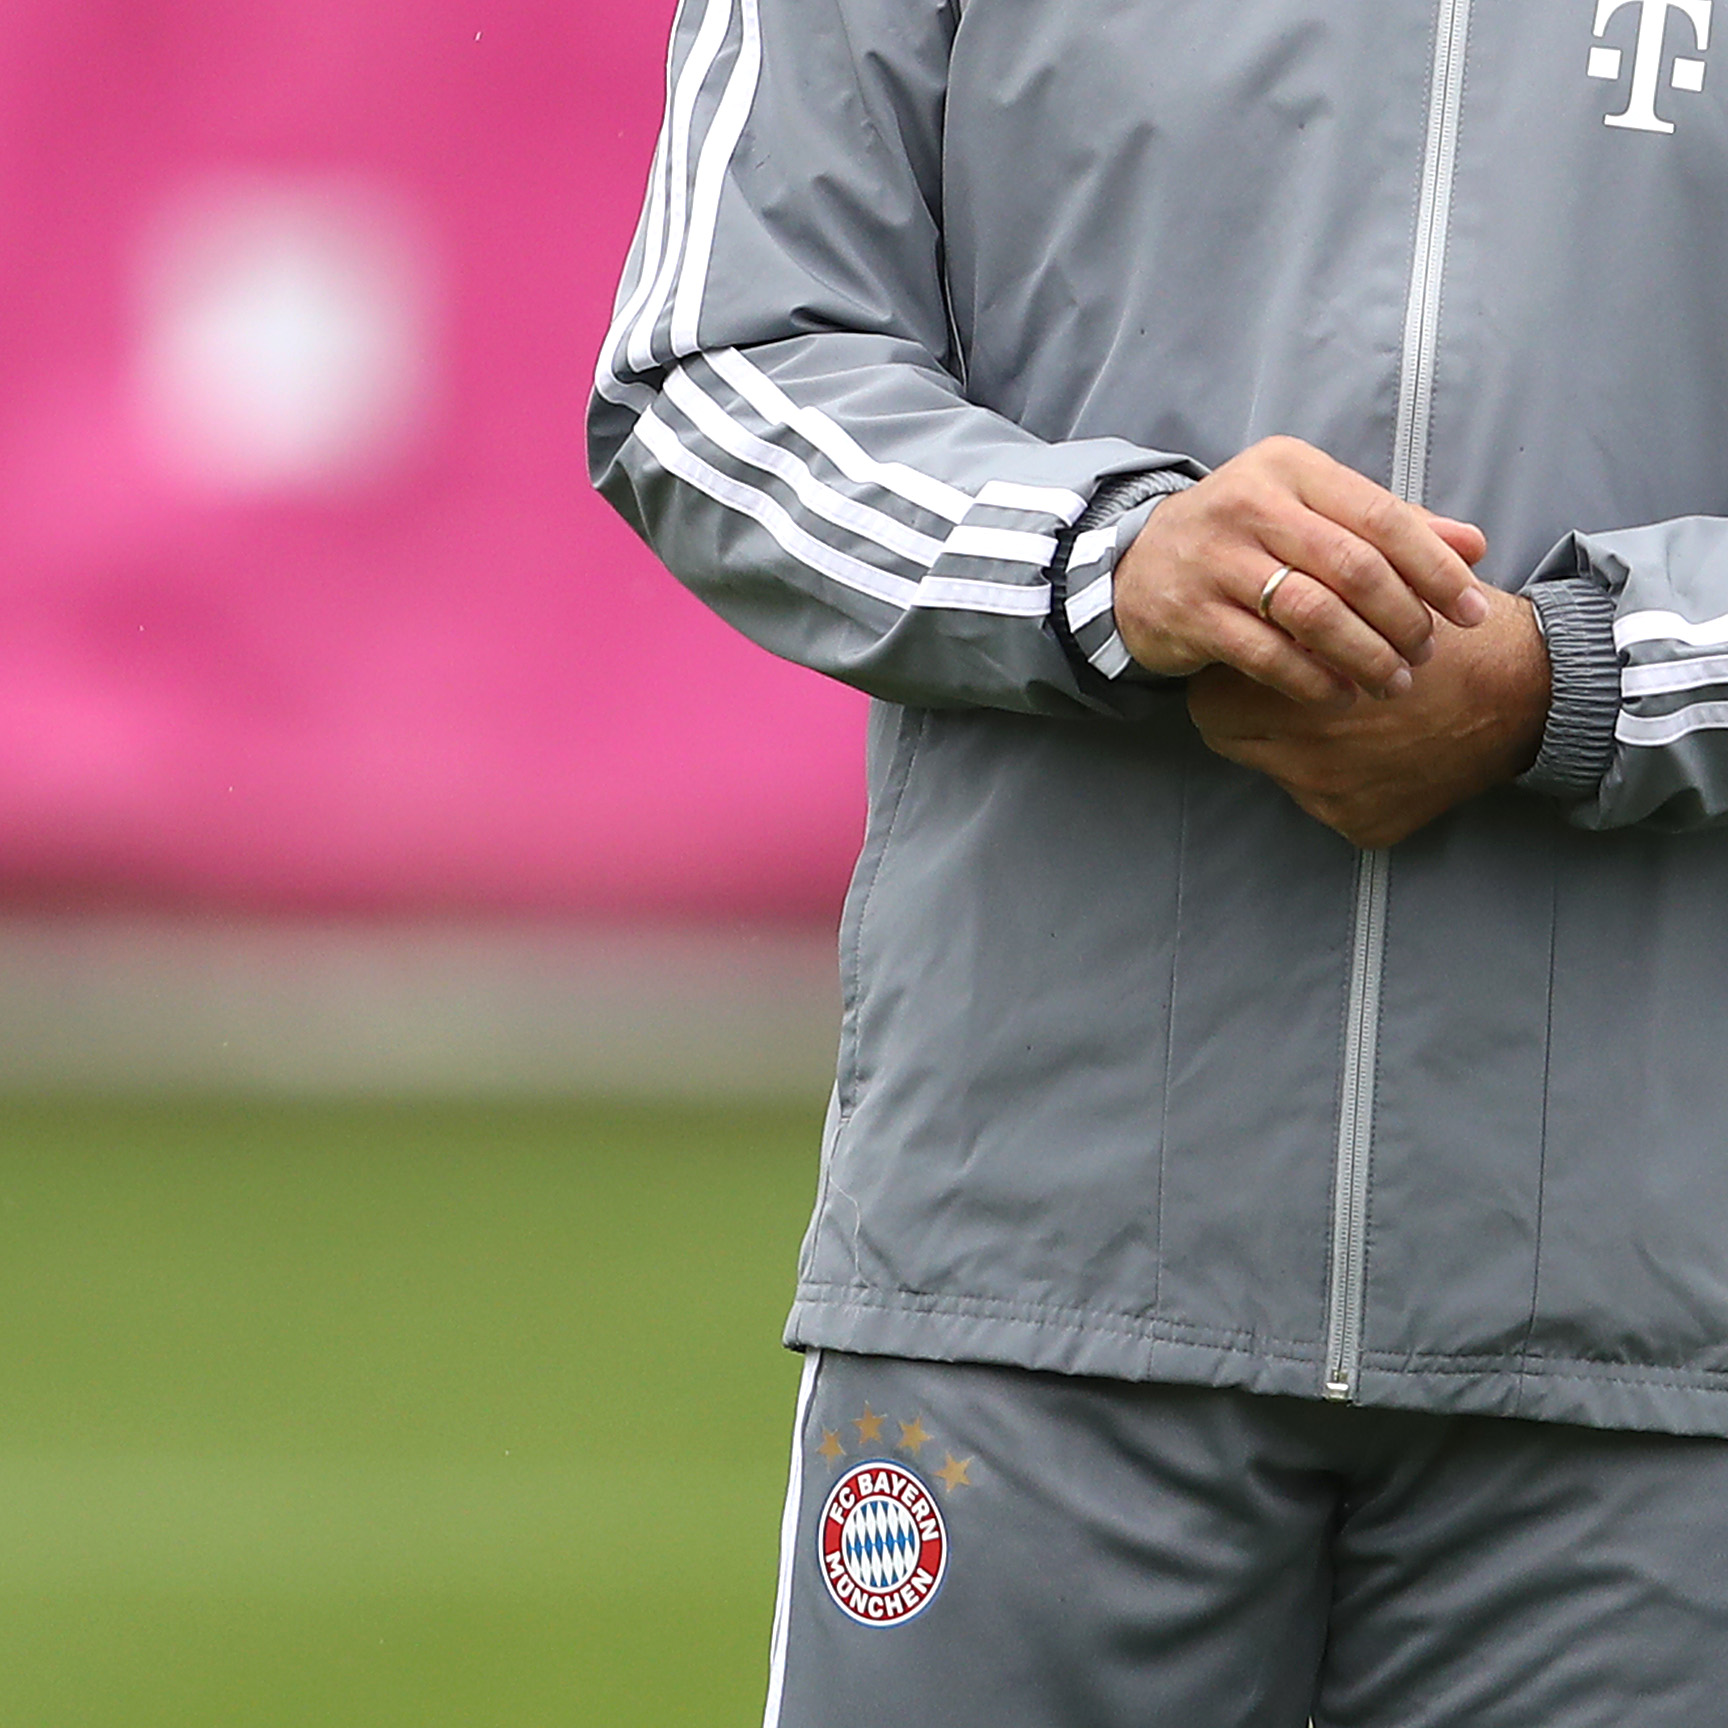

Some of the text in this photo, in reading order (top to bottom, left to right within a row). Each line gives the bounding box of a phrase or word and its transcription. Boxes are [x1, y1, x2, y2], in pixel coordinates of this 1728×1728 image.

[829, 1471, 940, 1542] FC BAYERN
[825, 1551, 934, 1618] MÜNCHEN
